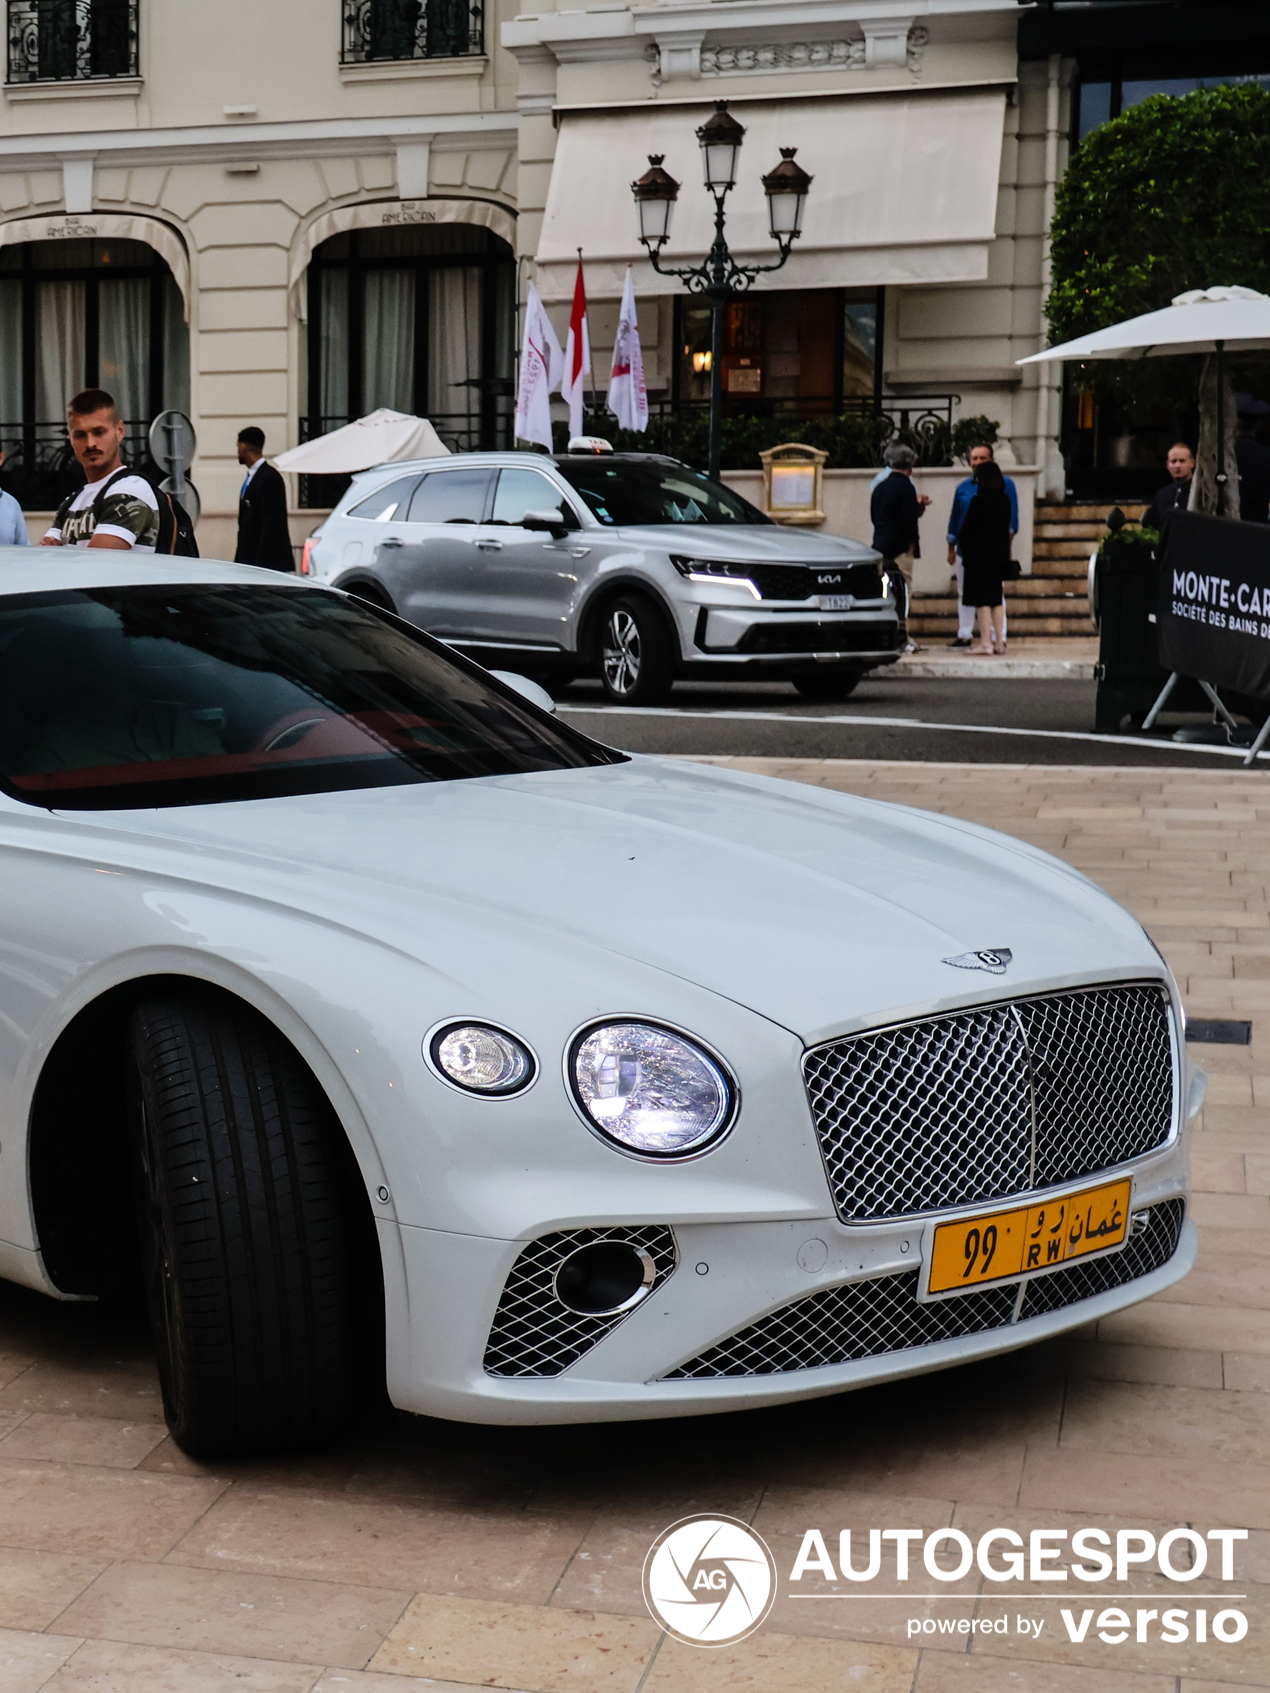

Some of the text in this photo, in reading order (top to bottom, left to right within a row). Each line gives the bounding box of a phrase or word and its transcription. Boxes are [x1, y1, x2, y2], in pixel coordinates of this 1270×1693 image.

[382, 211, 436, 224] AMERICAN
[47, 226, 97, 237] AMERICAN
[1172, 600, 1206, 623] SOCIÉTÉ
[1209, 610, 1226, 628] DES
[1229, 615, 1258, 636] BAINS
